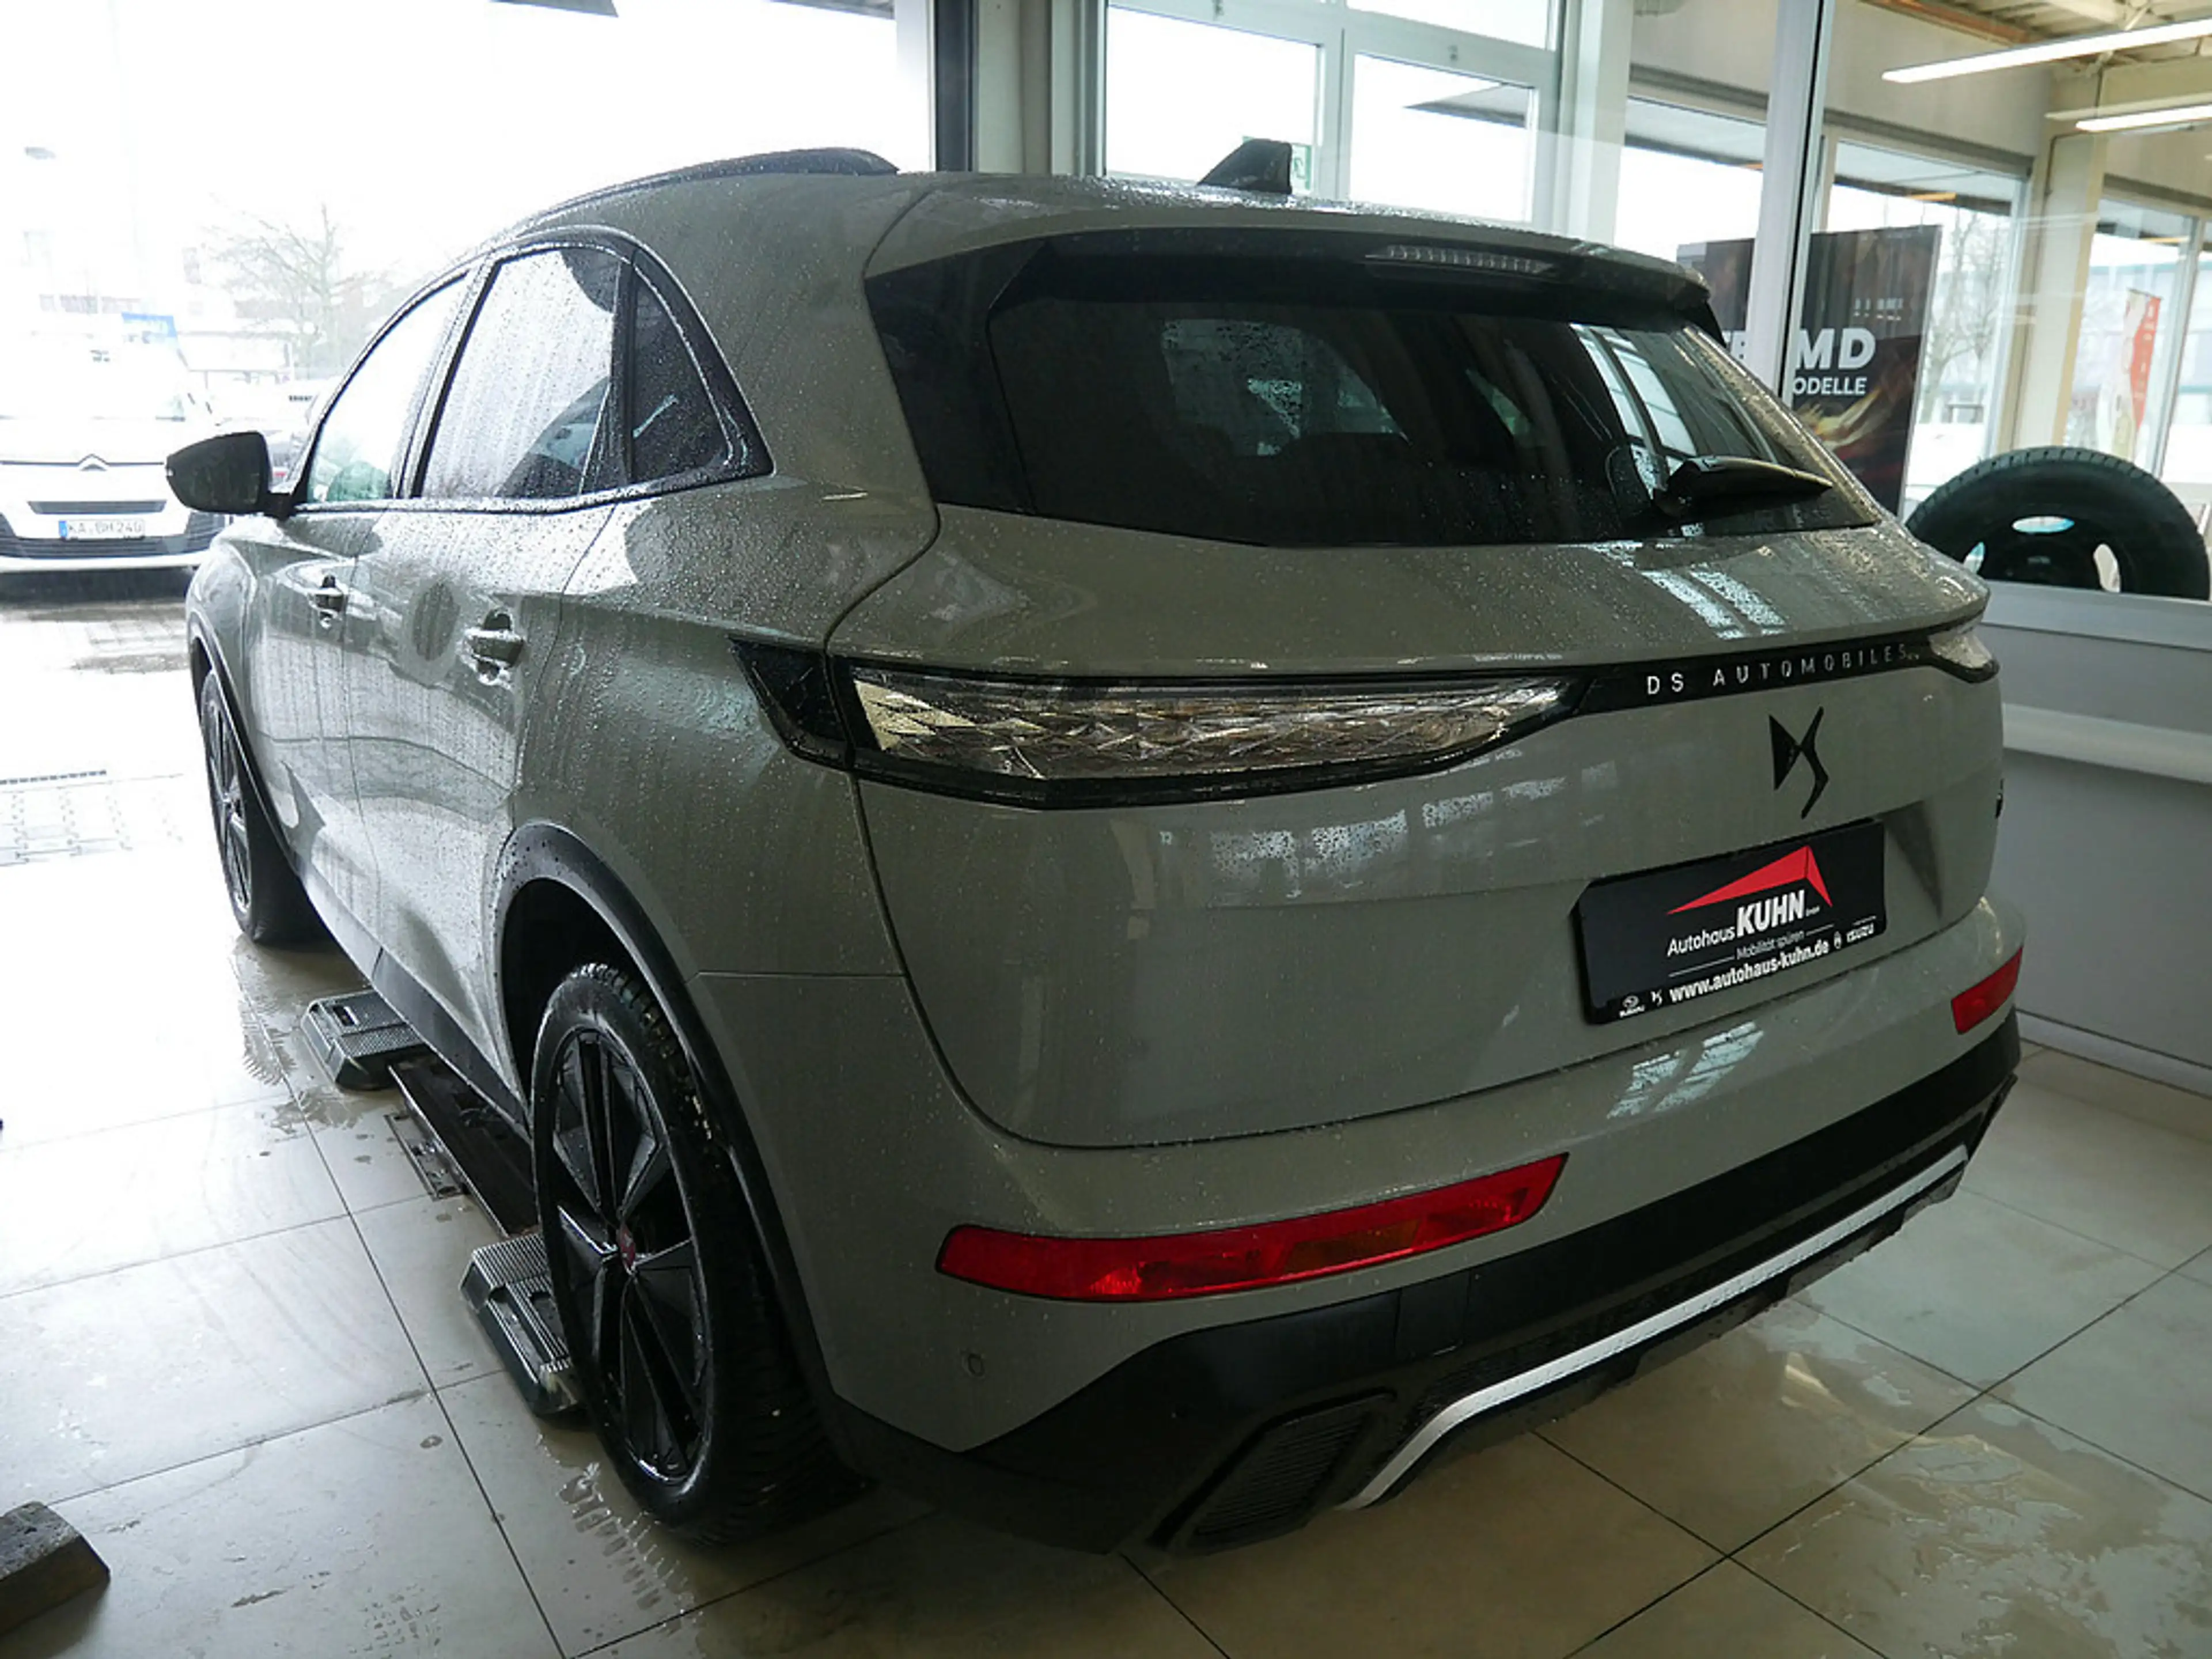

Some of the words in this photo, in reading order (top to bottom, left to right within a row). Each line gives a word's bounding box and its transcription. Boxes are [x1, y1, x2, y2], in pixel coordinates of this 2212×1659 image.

[1792, 376, 1867, 396] ODELLE
[1646, 671, 1684, 695] DS
[1712, 643, 1907, 687] AUTOMOBILES
[1666, 926, 1736, 957] Autohaus
[1736, 889, 1805, 938] KUHN
[1669, 939, 1830, 1003] www.autohaus-kuhn.de
